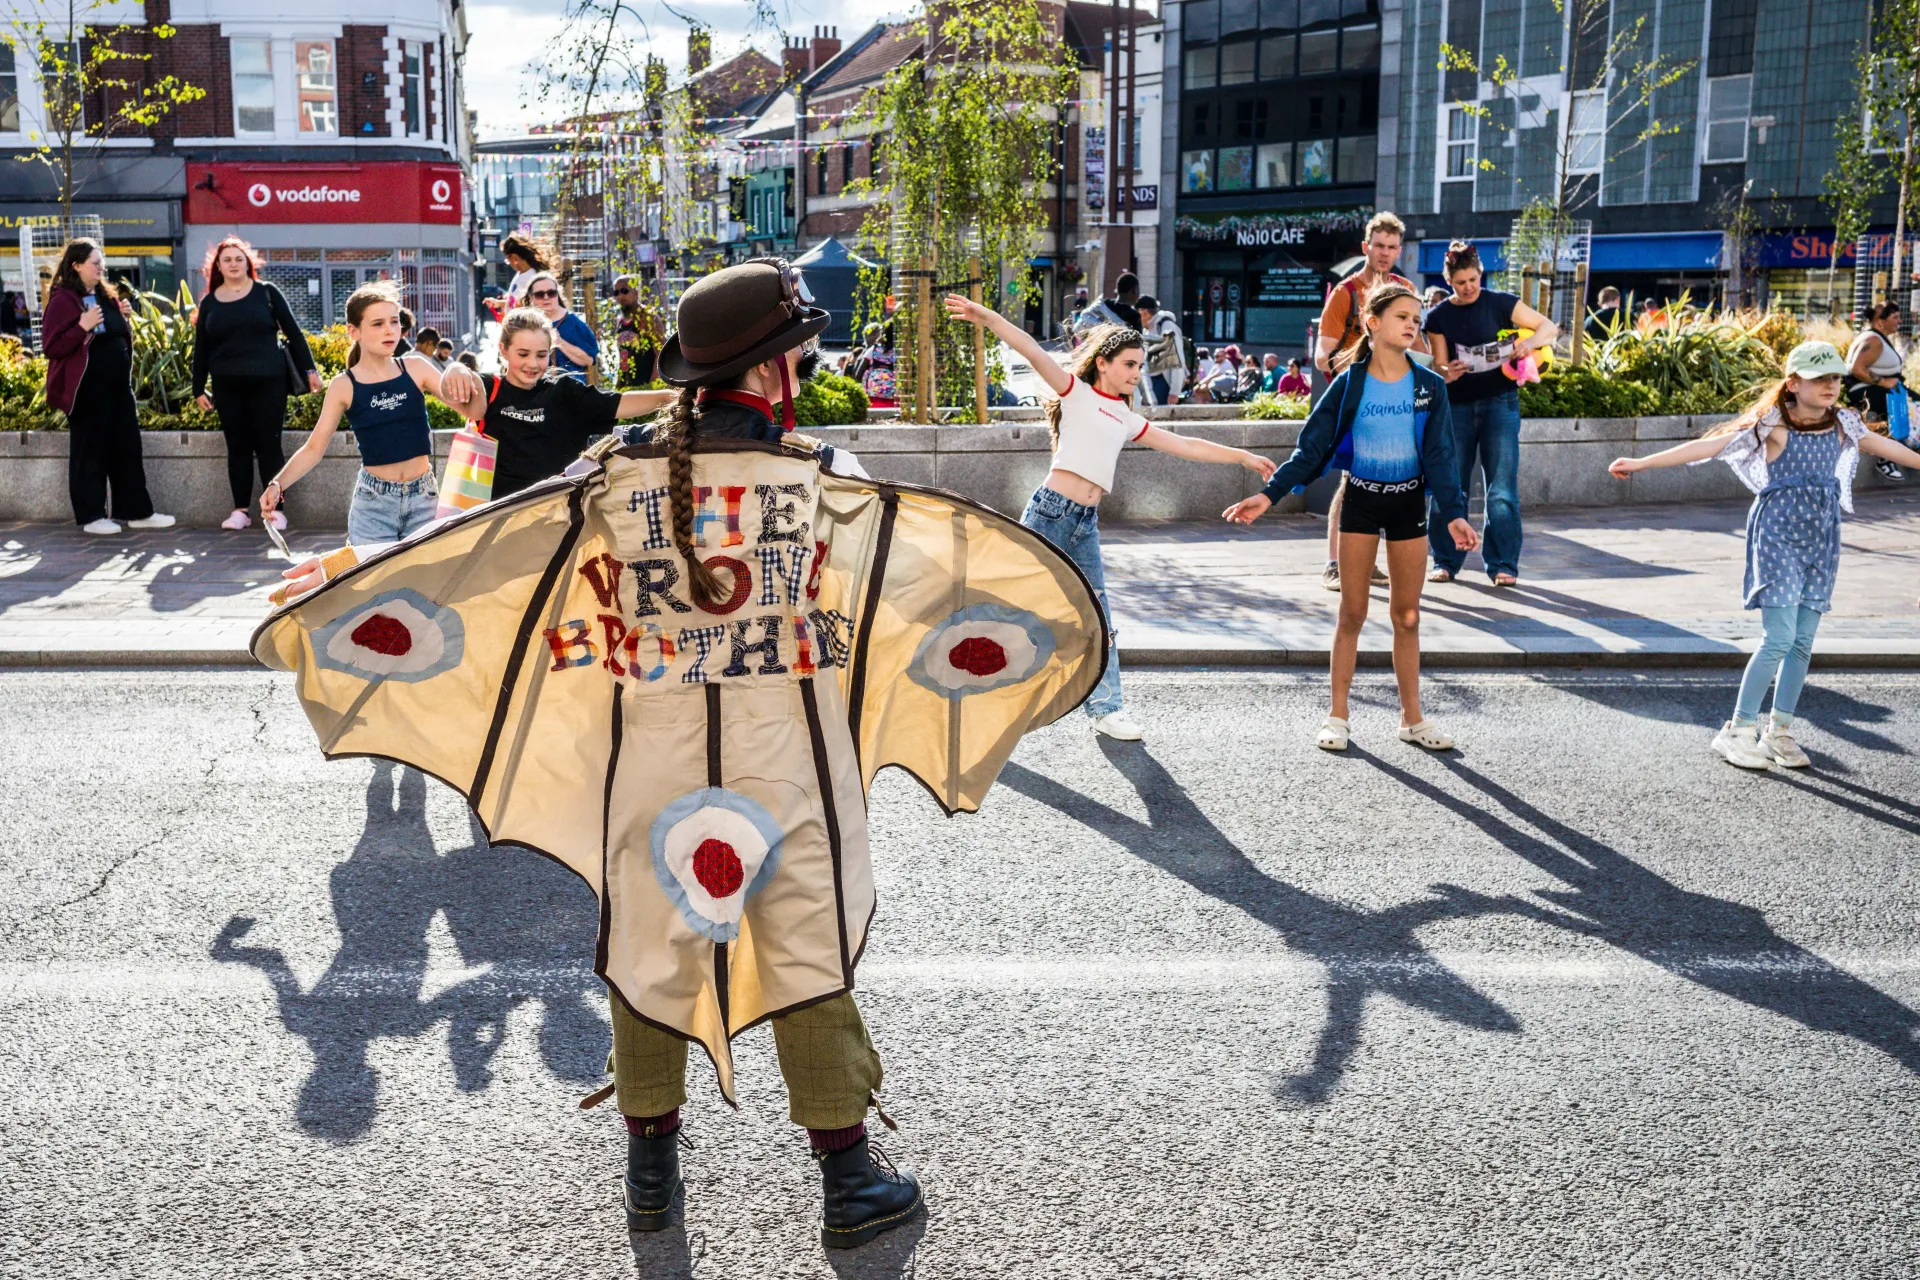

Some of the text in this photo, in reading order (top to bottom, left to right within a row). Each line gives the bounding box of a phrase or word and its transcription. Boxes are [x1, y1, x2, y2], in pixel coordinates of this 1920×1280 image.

[276, 186, 361, 202] vodafone
[1118, 187, 1156, 203] HNDS
[1236, 228, 1305, 246] No10 CAFE
[1349, 473, 1419, 494] NIKE PRO
[626, 483, 812, 550] THE
